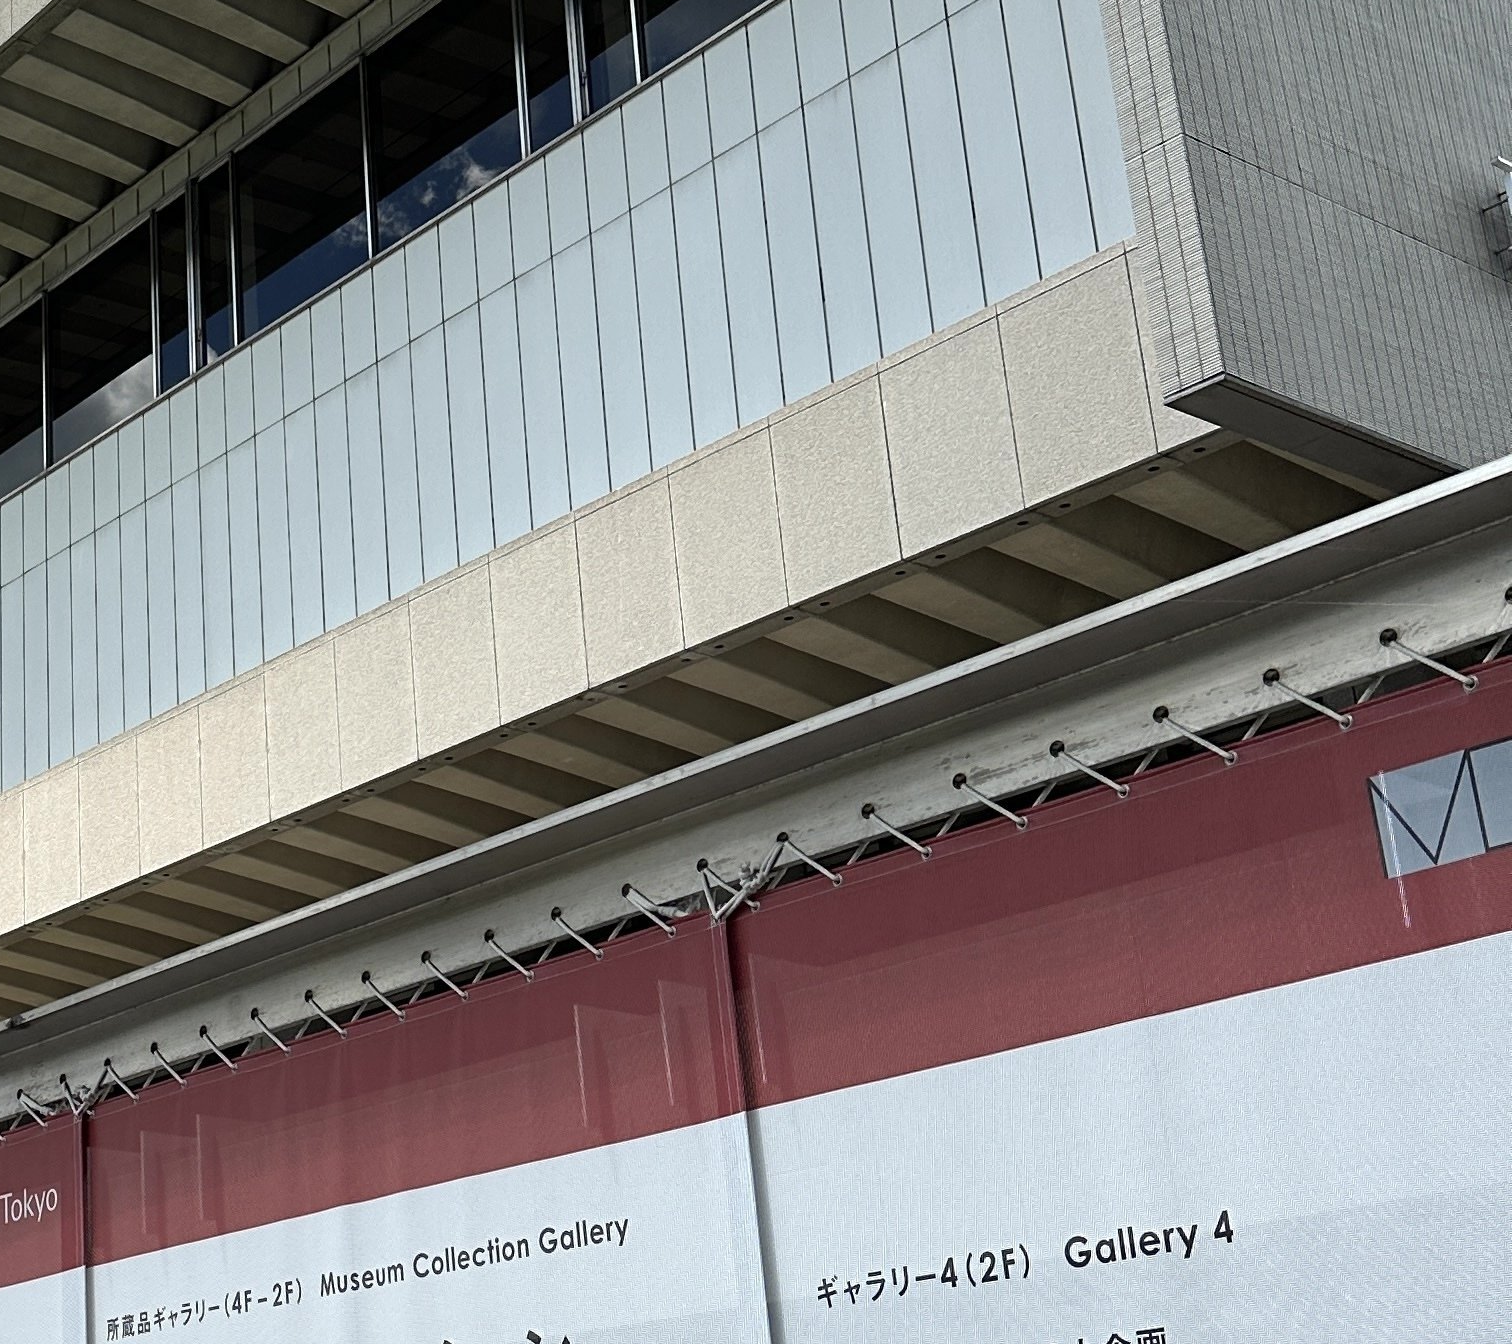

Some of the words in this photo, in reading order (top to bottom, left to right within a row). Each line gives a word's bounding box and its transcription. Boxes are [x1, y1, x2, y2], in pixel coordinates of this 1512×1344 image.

[0, 1187, 58, 1225] Tokyo
[320, 1259, 404, 1298] Museum
[413, 1236, 530, 1278] Collection
[539, 1218, 628, 1254] Gallery
[1064, 1223, 1198, 1272] Gallery
[1213, 1210, 1235, 1244] 4
